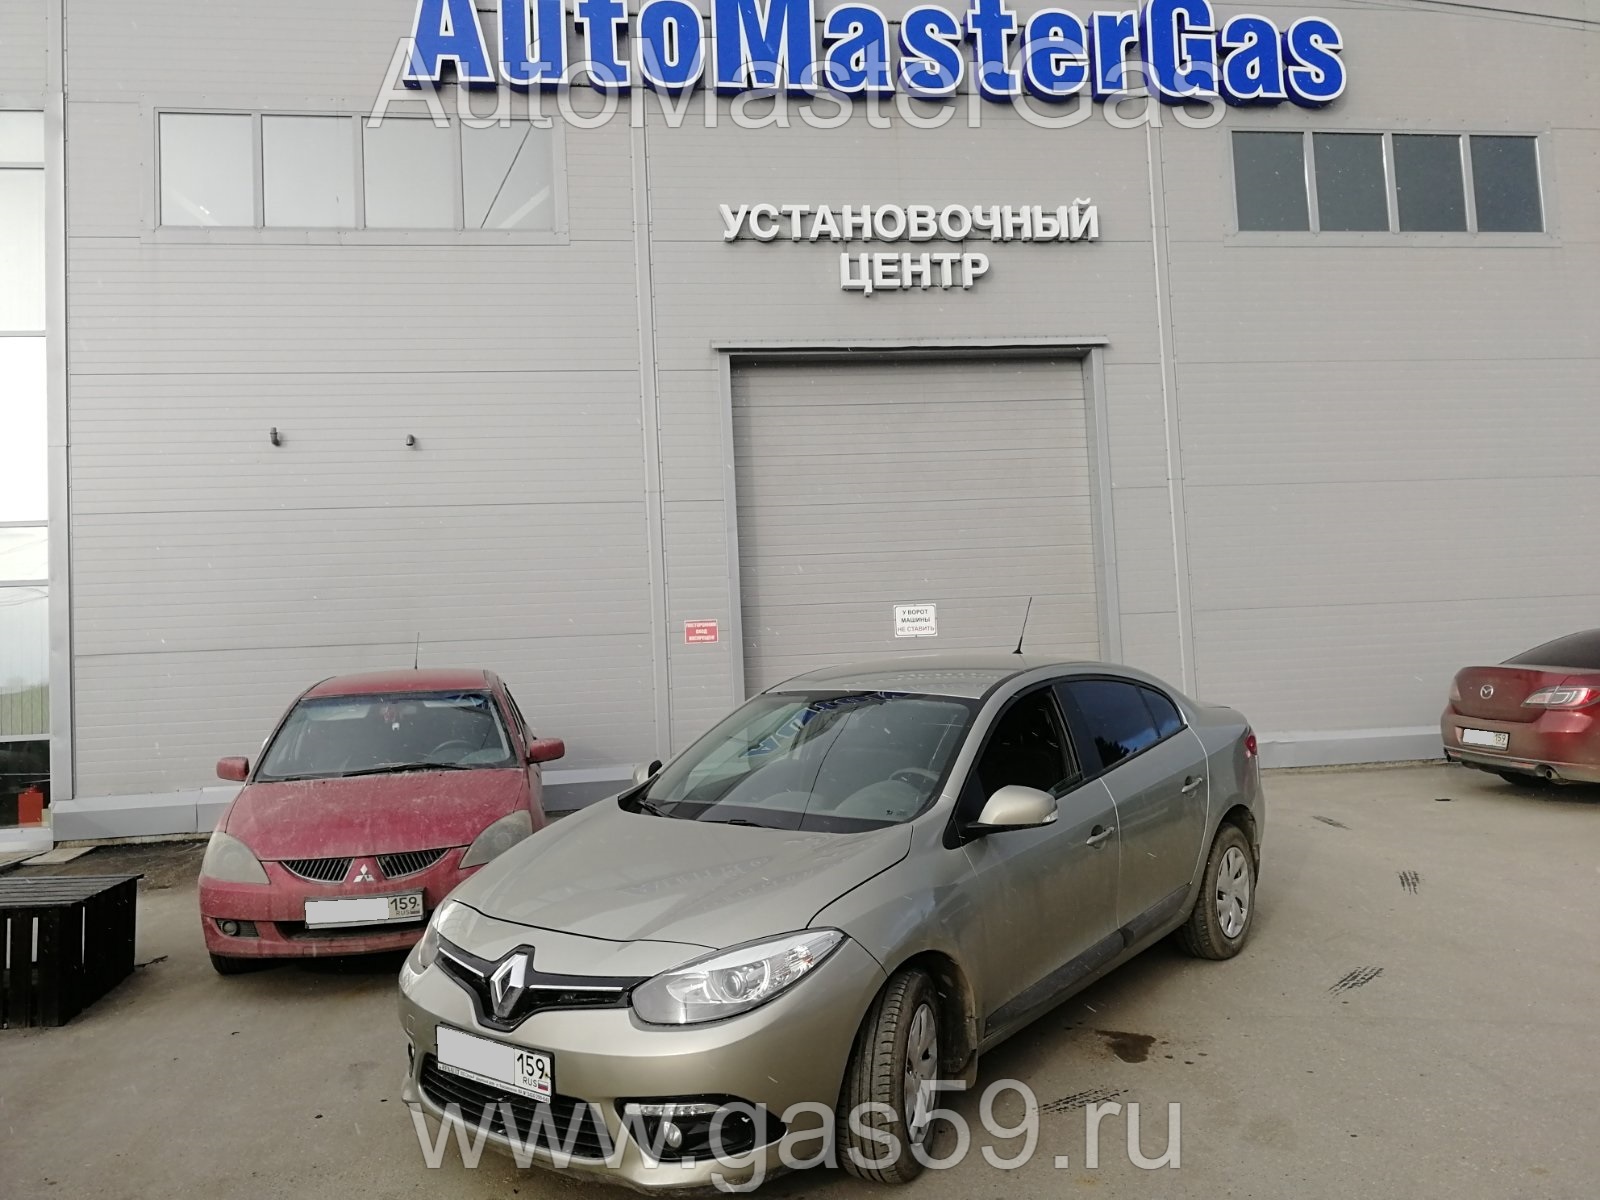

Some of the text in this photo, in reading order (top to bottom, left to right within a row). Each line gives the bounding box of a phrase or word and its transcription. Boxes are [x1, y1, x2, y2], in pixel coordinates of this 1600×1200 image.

[401, 0, 1348, 106] AutoMasterGas
[719, 197, 1099, 242] УСТАНОВОЧНЫЙ
[839, 252, 990, 296] ЦЕНТР
[1495, 733, 1506, 742] 159
[390, 896, 417, 910] 159
[517, 1053, 545, 1079] 159
[522, 1076, 538, 1088] RUS
